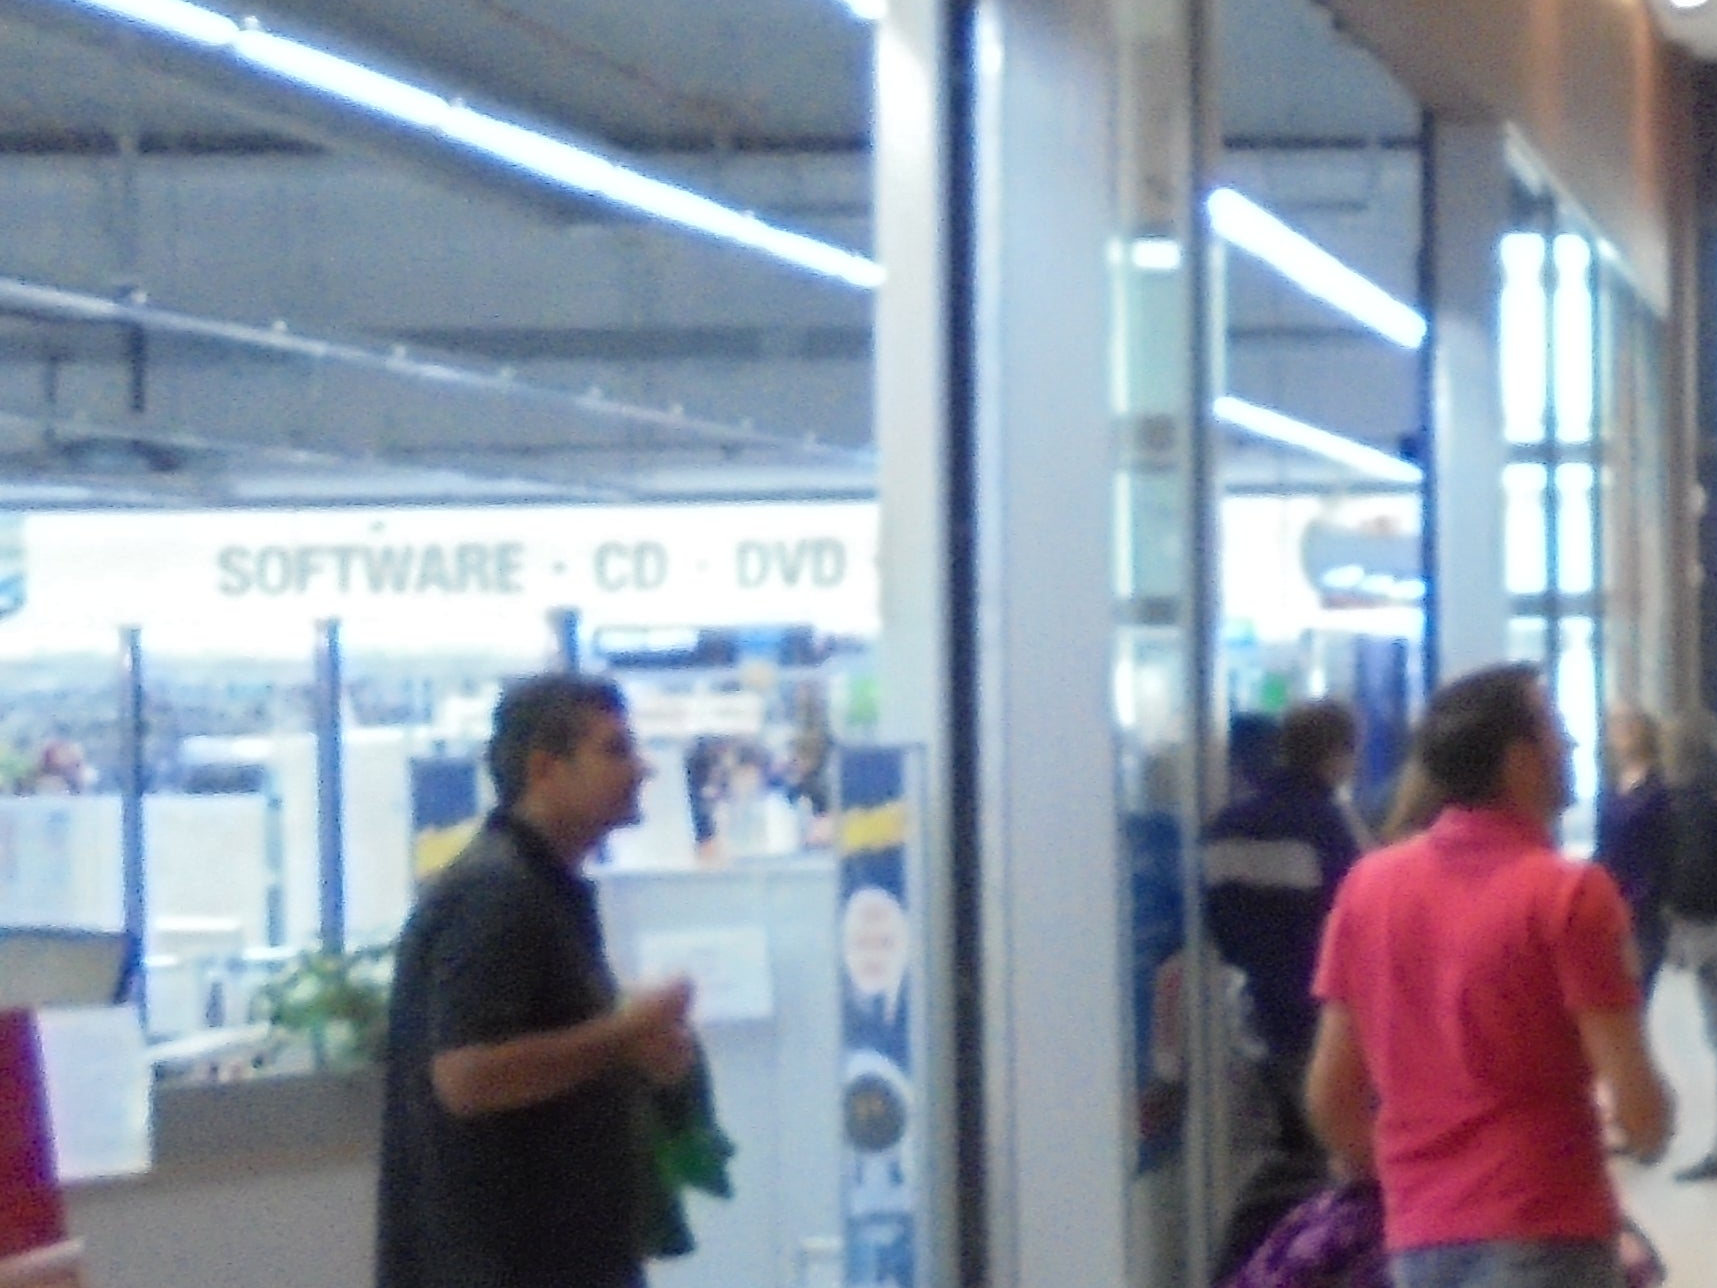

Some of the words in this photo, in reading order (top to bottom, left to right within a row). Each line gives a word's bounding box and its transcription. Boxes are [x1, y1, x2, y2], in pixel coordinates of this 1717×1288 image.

[217, 540, 525, 597] SOFTWARE
[593, 539, 670, 592] CD
[735, 536, 848, 590] DVD
